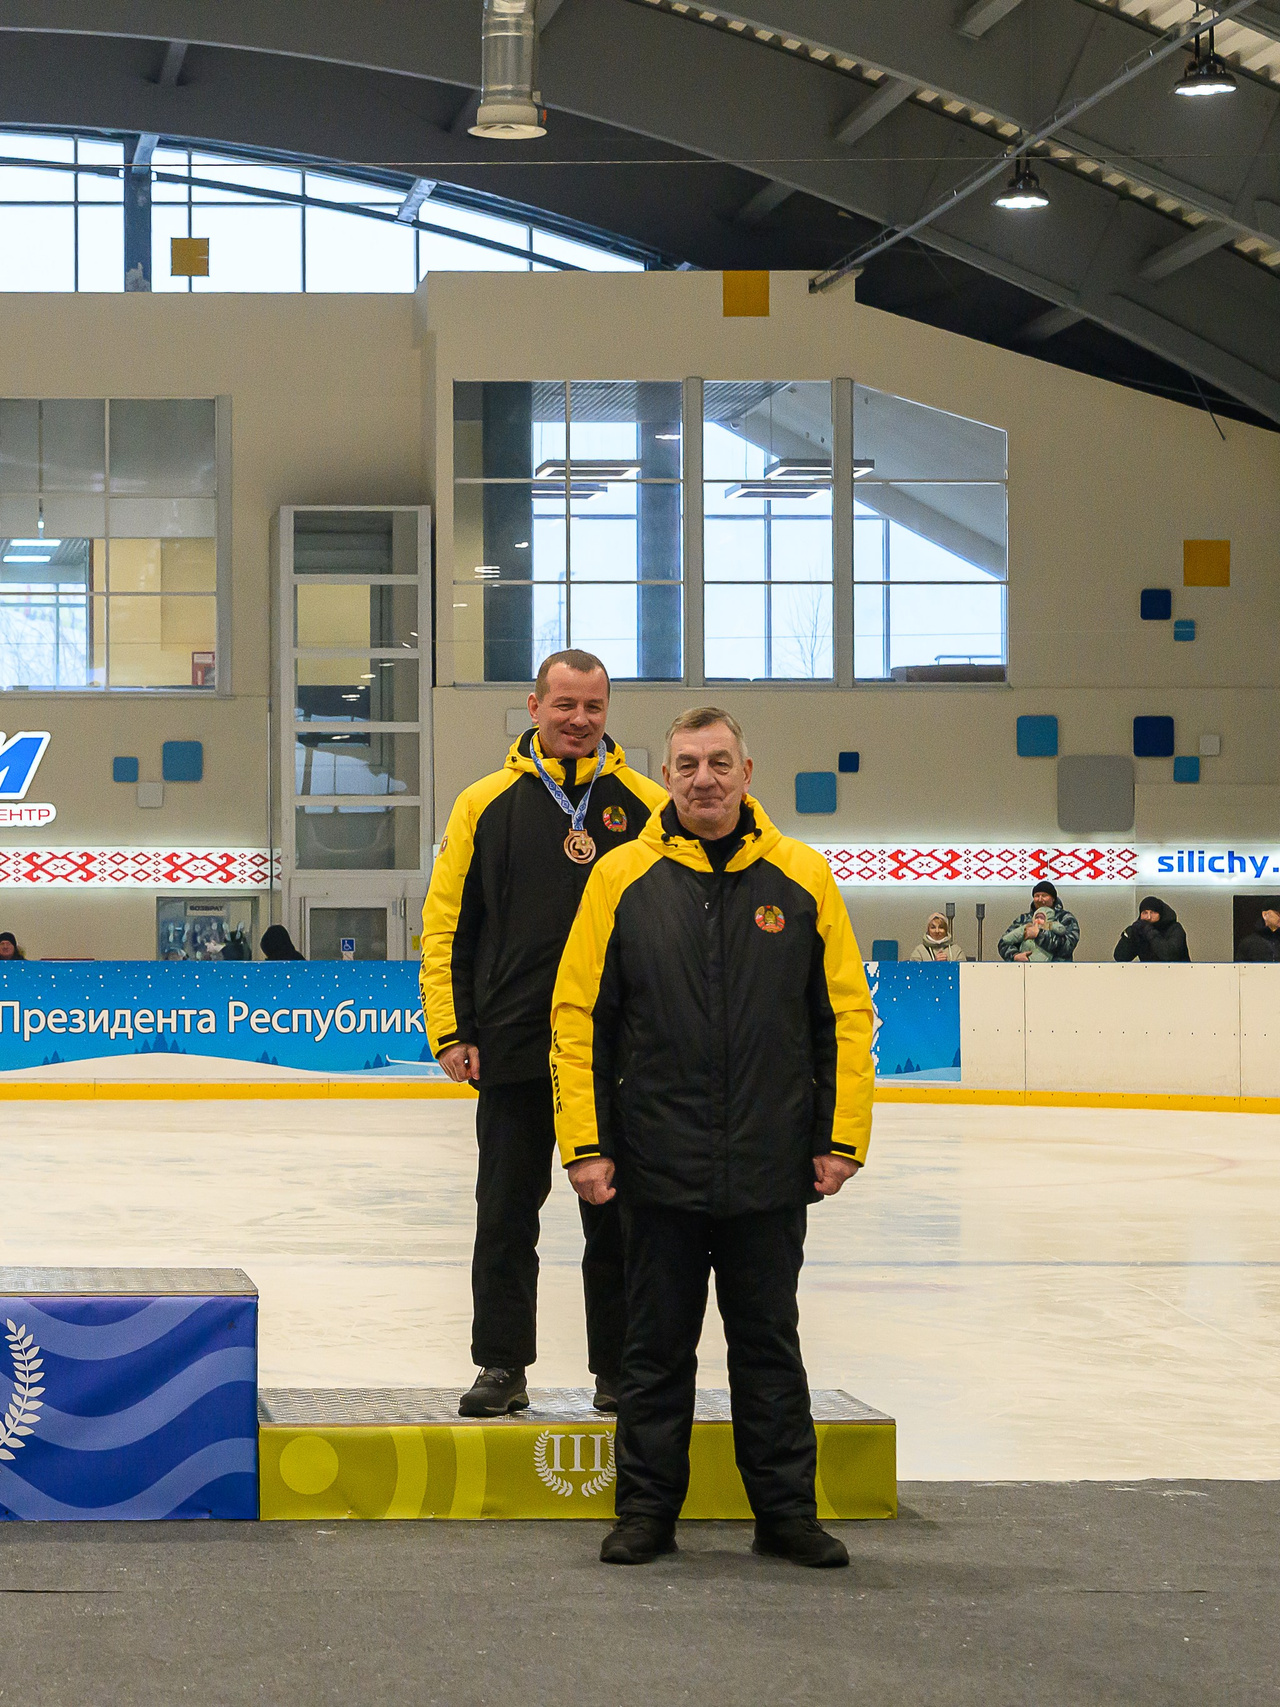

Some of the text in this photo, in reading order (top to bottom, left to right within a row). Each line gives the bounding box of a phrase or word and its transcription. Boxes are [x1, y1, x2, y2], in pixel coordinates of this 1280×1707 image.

[1157, 850, 1280, 879] silichy.
[227, 1000, 425, 1042] Республик
[548, 1434, 606, 1472] III
